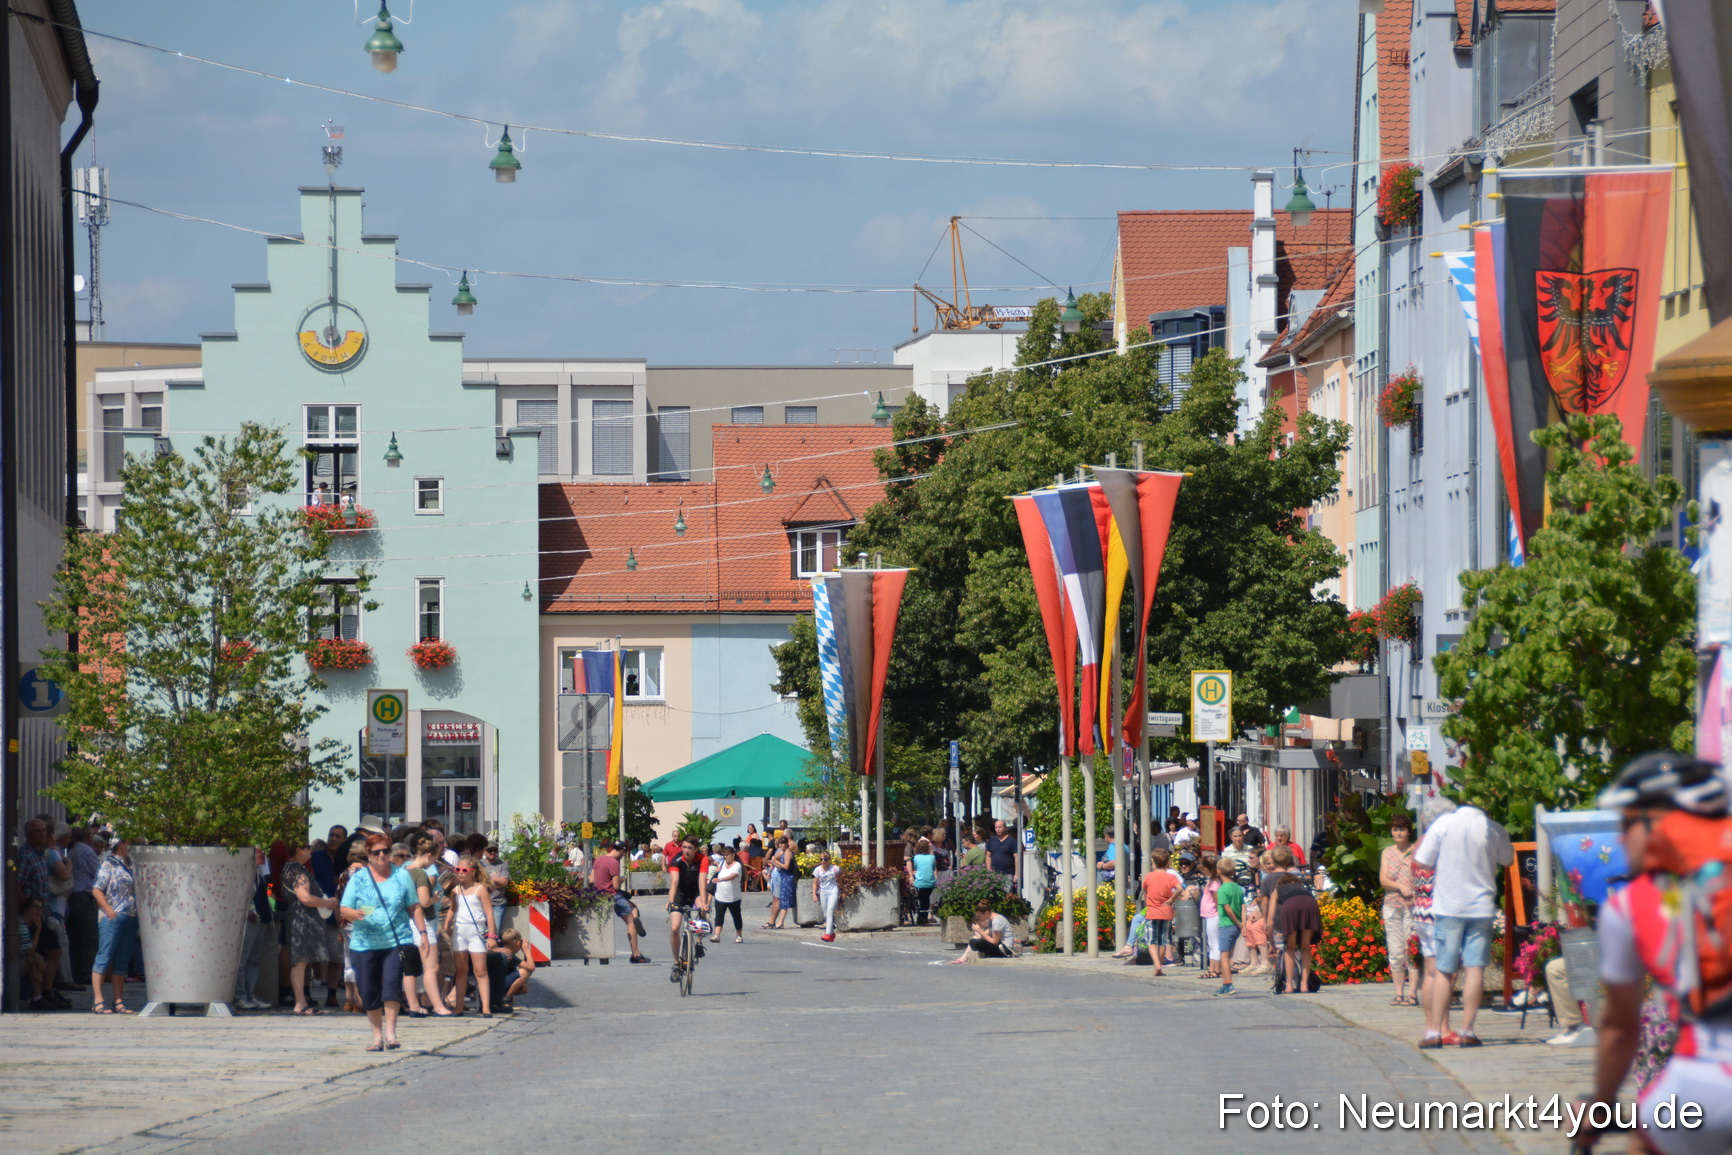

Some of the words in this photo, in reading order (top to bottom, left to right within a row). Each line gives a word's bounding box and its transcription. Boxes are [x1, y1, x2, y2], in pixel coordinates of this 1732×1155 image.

[1205, 682, 1218, 699] H
[380, 701, 395, 717] H
[427, 723, 468, 731] KIRSCH
[472, 722, 478, 730] &
[1026, 832, 1033, 842] P
